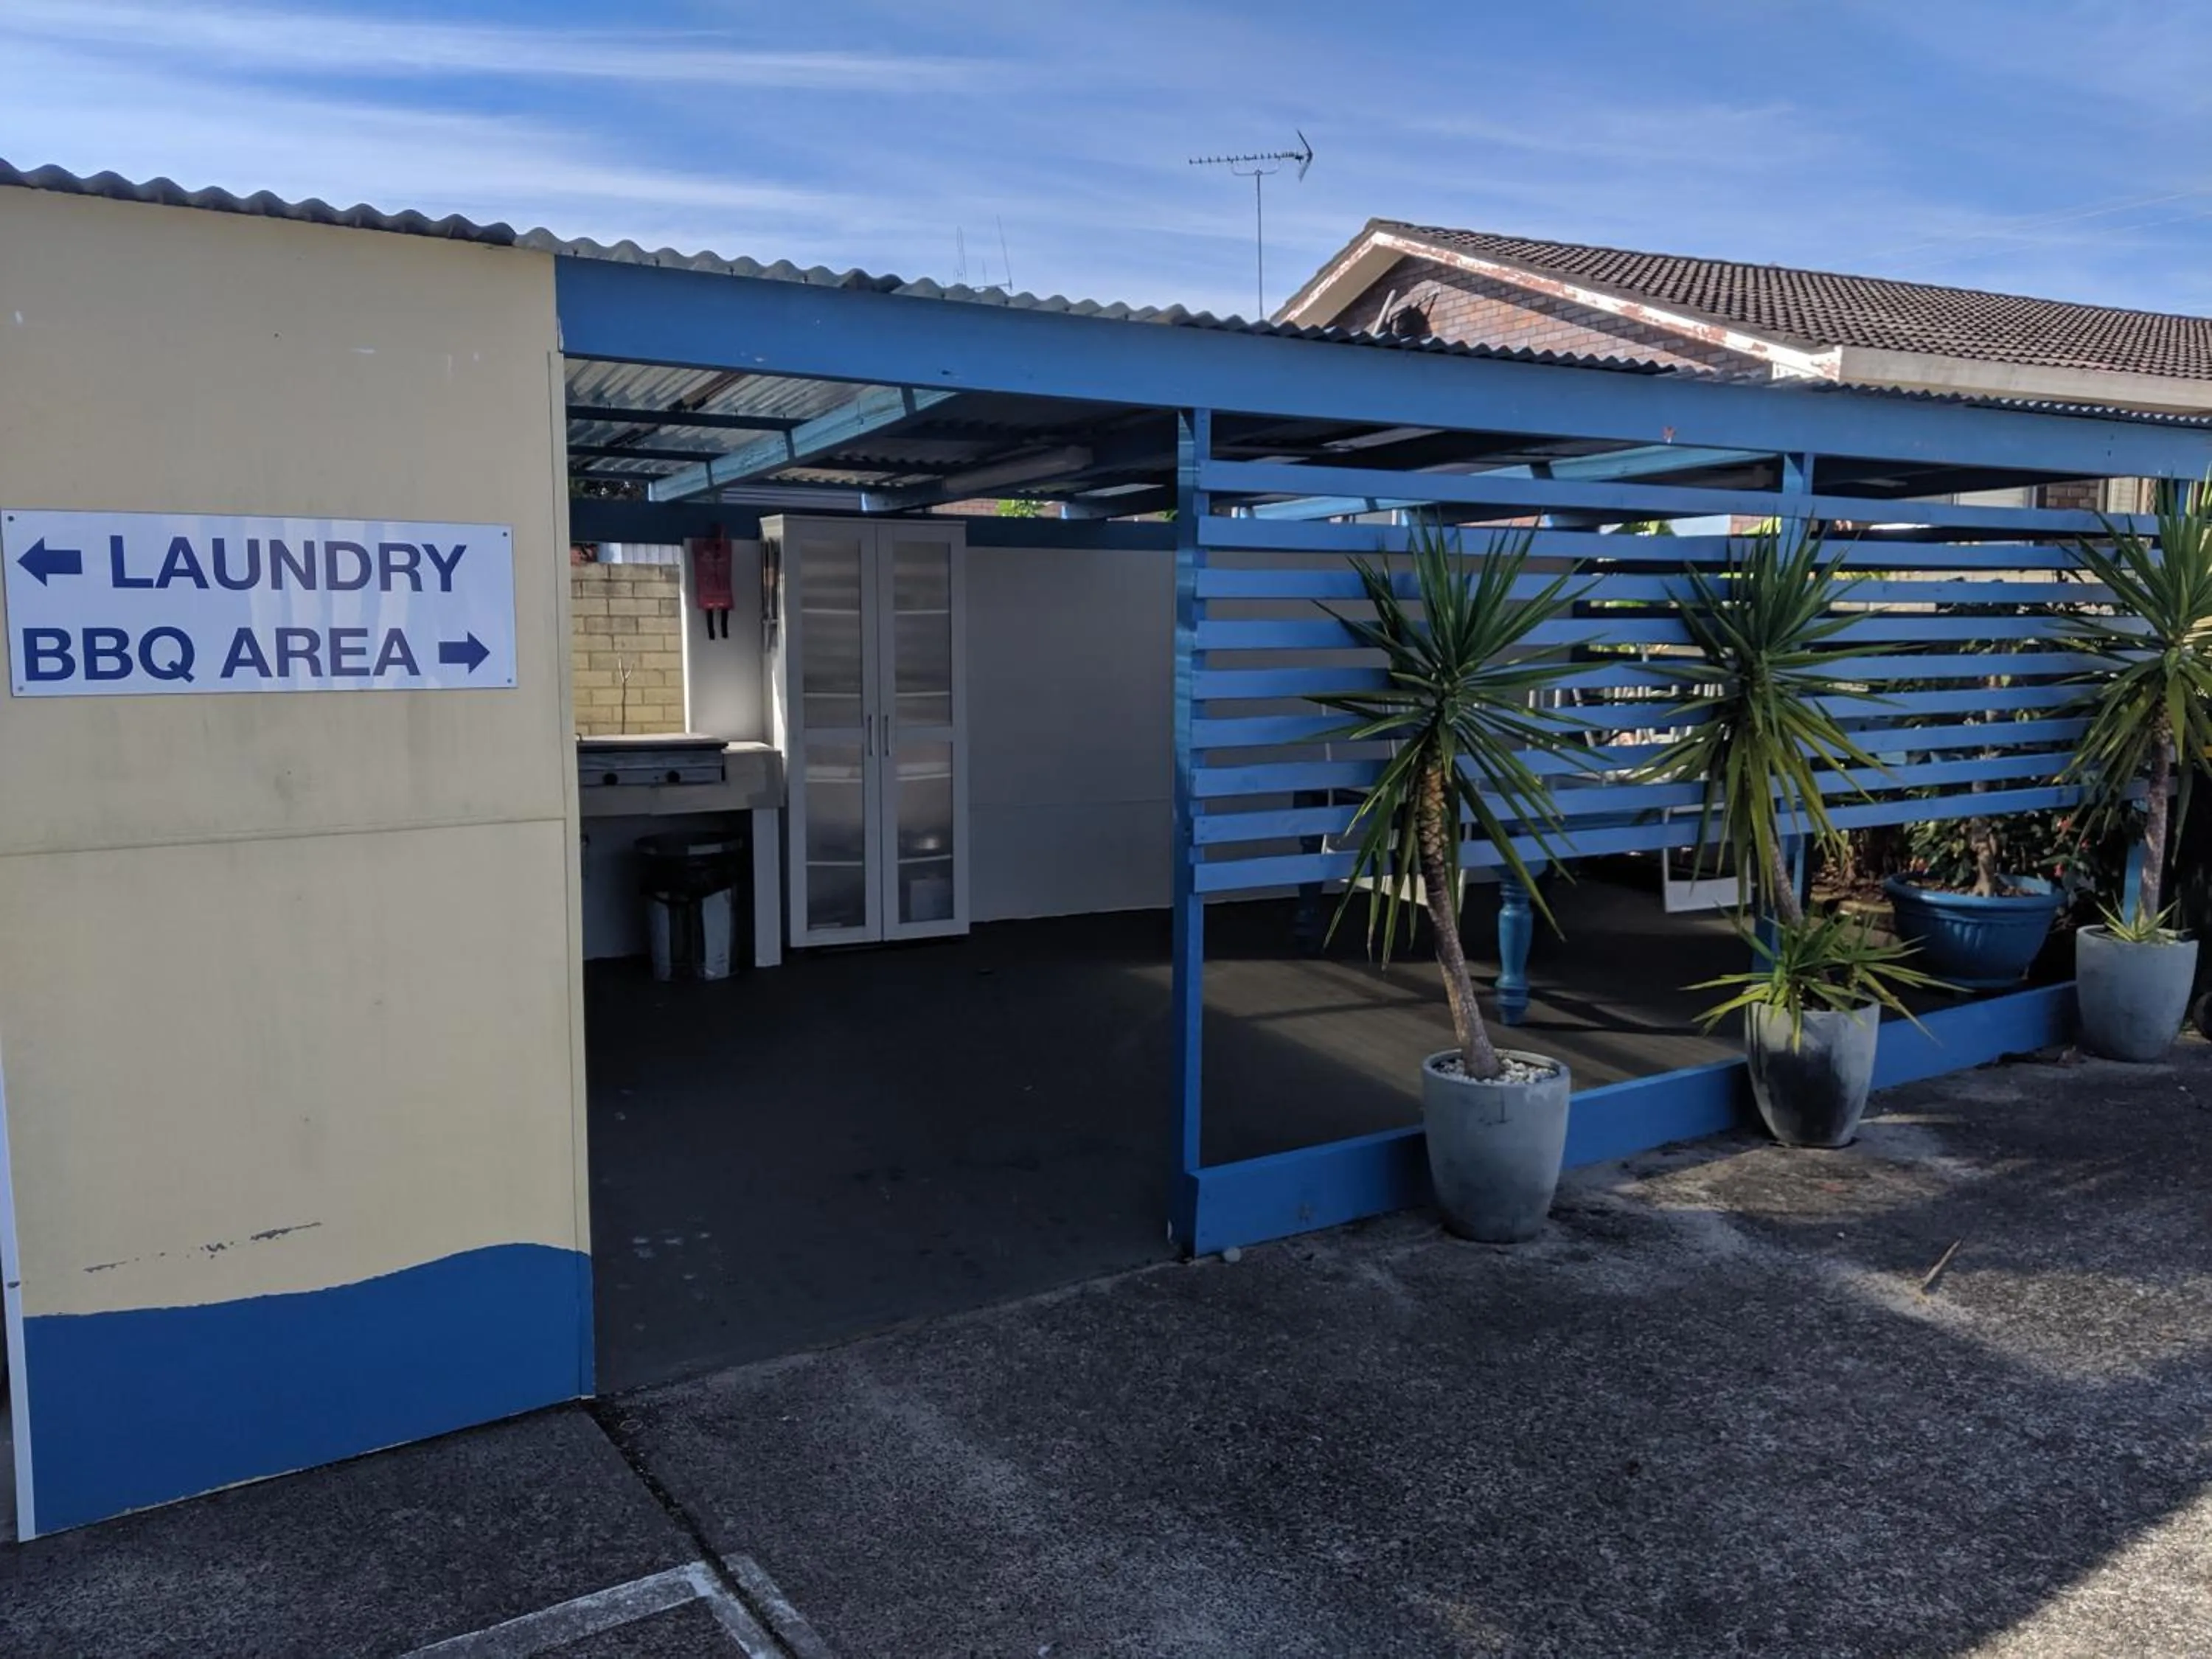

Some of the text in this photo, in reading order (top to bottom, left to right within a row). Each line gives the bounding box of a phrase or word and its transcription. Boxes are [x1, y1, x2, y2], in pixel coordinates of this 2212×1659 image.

[109, 535, 467, 592] LAUNDRY
[22, 626, 421, 683] BBQ AREA
